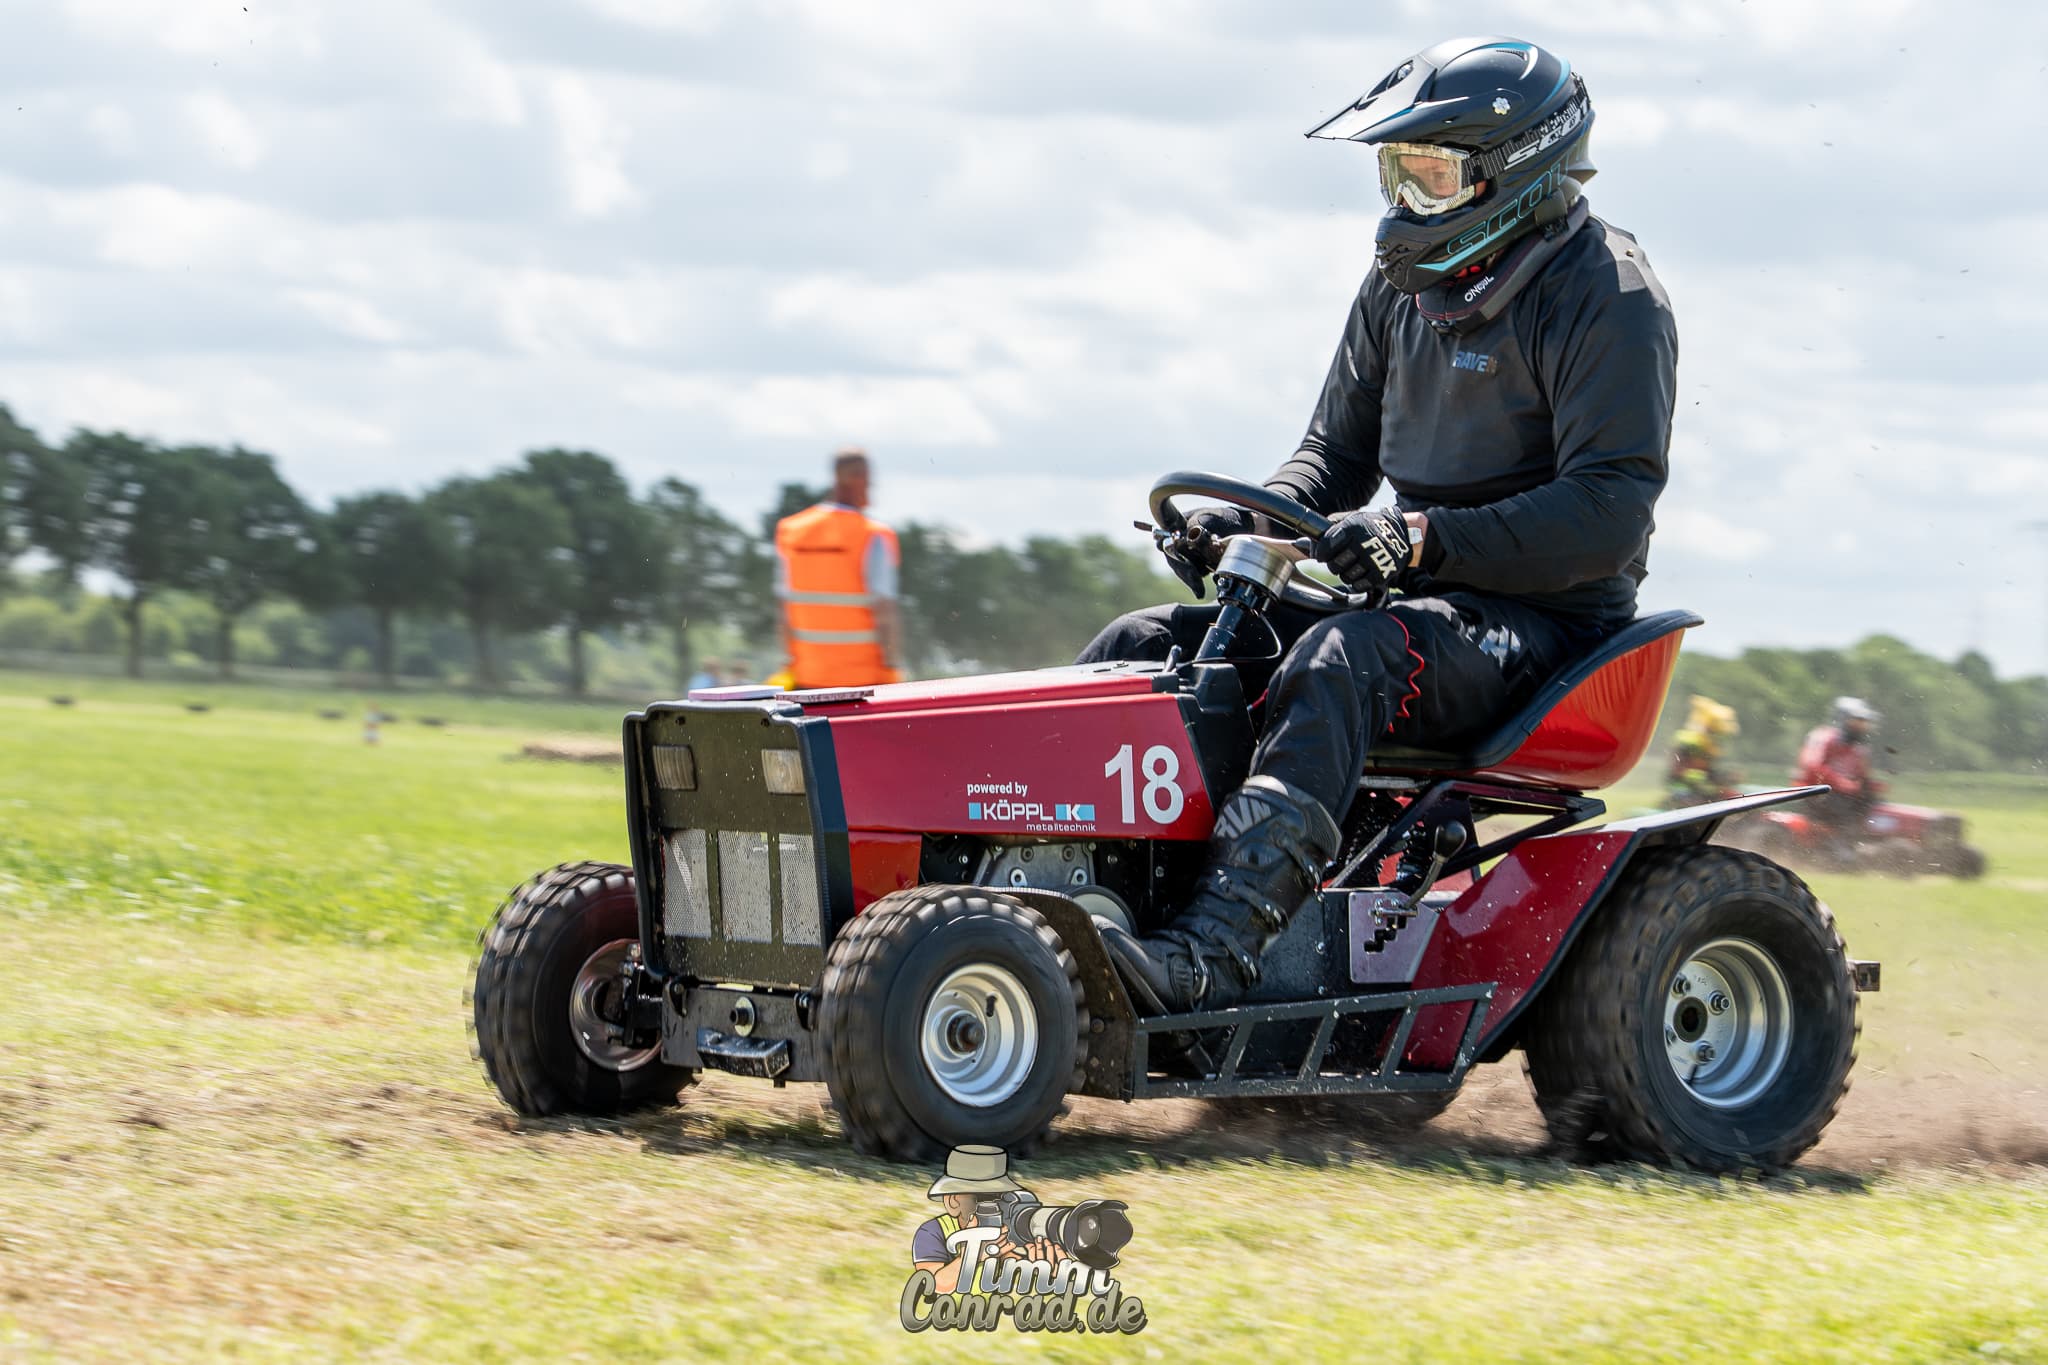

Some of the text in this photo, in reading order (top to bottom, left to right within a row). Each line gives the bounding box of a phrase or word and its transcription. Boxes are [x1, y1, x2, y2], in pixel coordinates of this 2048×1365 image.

[1361, 536, 1397, 579] FOX
[966, 781, 1029, 798] powered by
[1104, 743, 1185, 825] 18
[983, 799, 1054, 822] KÖPPL
[1026, 822, 1097, 832] metalltechnik
